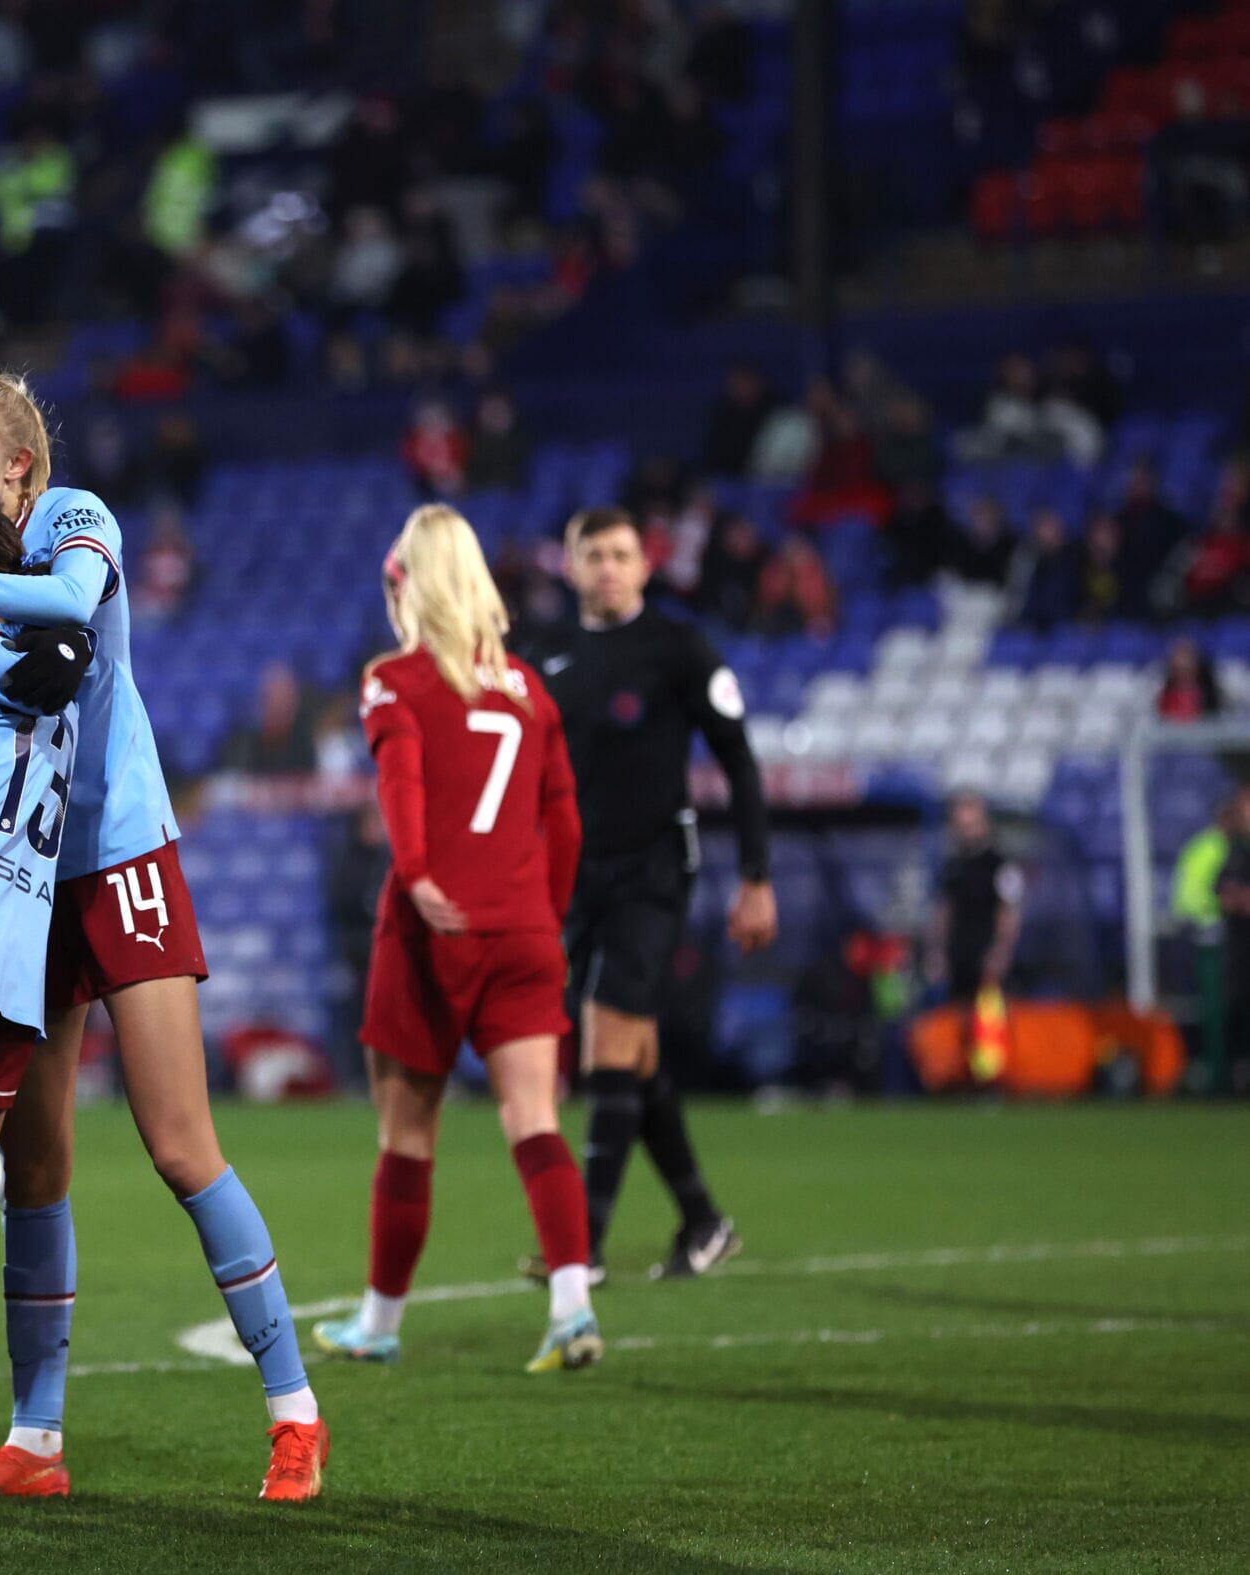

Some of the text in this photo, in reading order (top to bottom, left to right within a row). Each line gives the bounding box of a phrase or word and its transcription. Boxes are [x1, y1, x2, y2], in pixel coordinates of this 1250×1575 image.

[52, 508, 106, 530] NEXEN
[62, 517, 102, 530] TIRE
[466, 710, 523, 834] 7
[105, 861, 170, 935] 14
